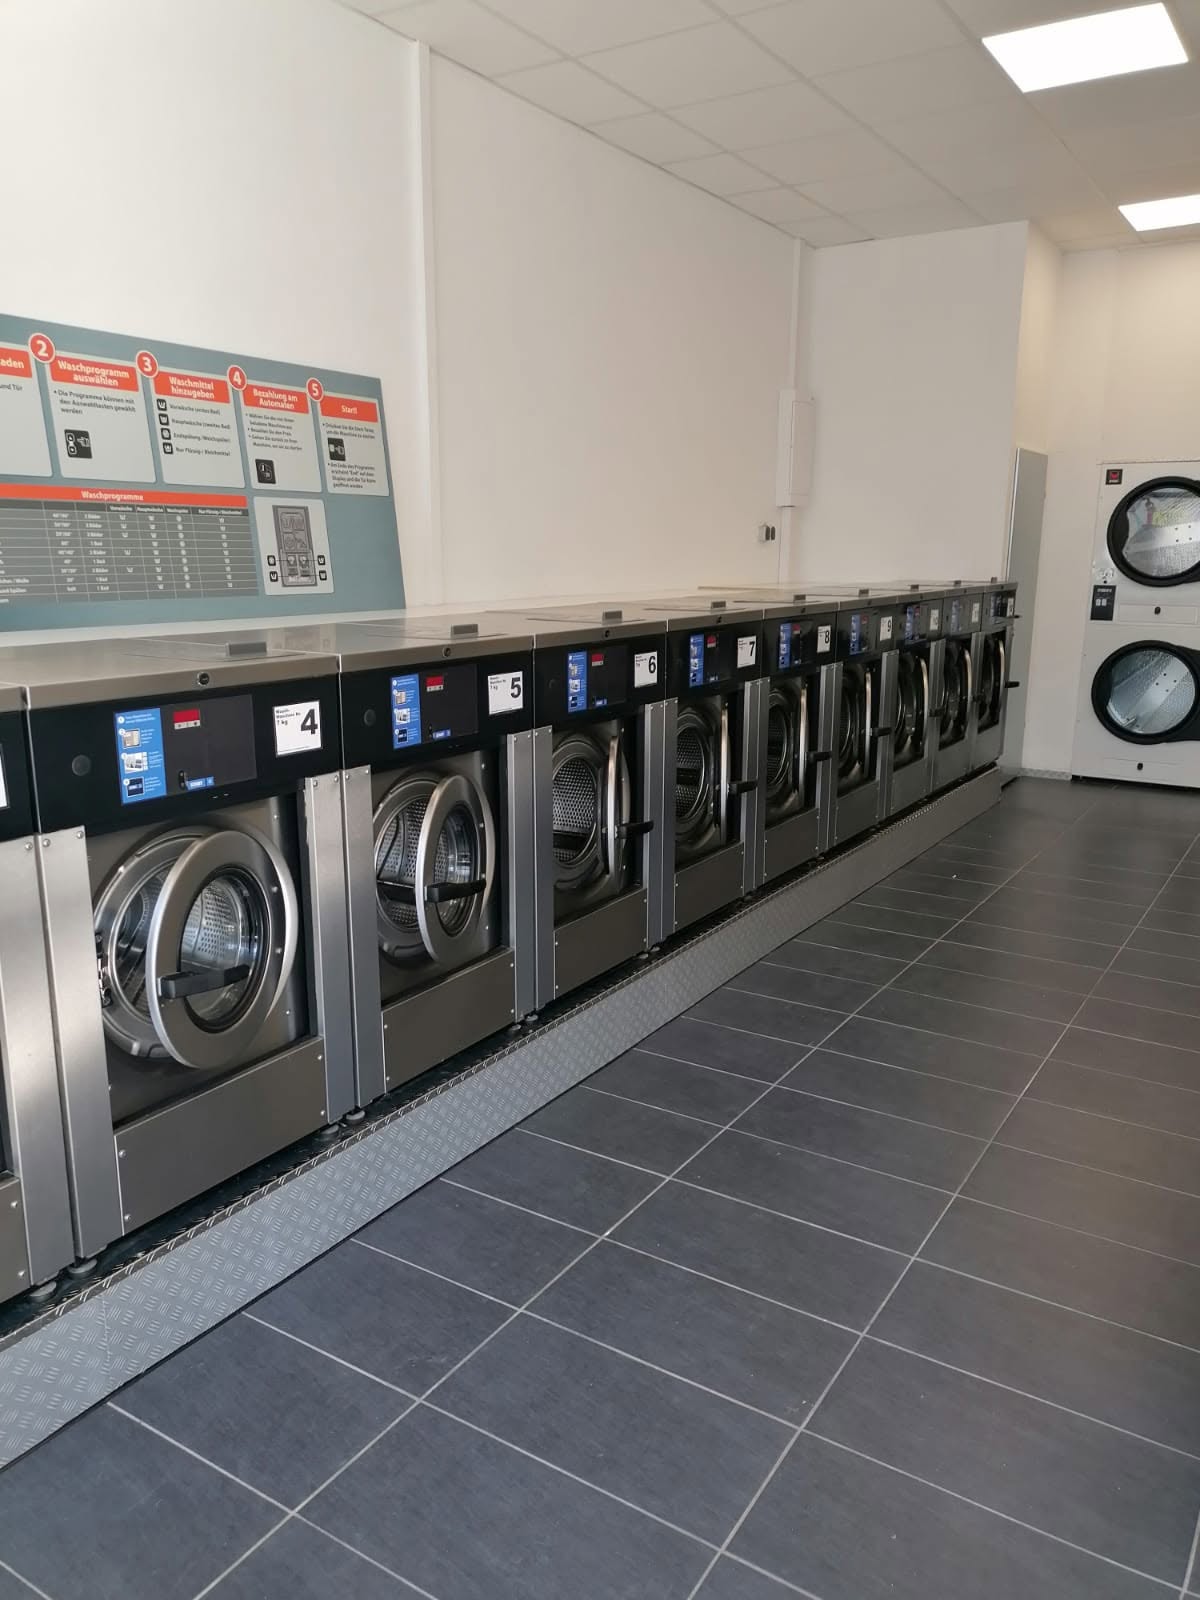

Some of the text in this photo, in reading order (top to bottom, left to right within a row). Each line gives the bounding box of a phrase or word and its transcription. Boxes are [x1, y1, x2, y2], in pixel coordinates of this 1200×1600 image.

[36, 340, 49, 357] 2
[58, 360, 130, 379] Waschprogramm
[142, 357, 152, 372] 3
[73, 374, 119, 387] auswählen
[169, 376, 214, 390] Waschmittel
[233, 371, 242, 386] 4
[69, 391, 102, 401] Programme
[171, 386, 215, 399] hinzugeben
[253, 388, 298, 402] Bezahlung am
[312, 382, 319, 396] 5
[259, 398, 294, 409] Automaten
[81, 490, 144, 502] Waschprogramme
[887, 619, 892, 632] 9
[824, 630, 830, 644] 8
[749, 641, 756, 657] 7
[648, 655, 656, 674] 6
[510, 676, 521, 699] 5
[300, 708, 318, 735] 4
